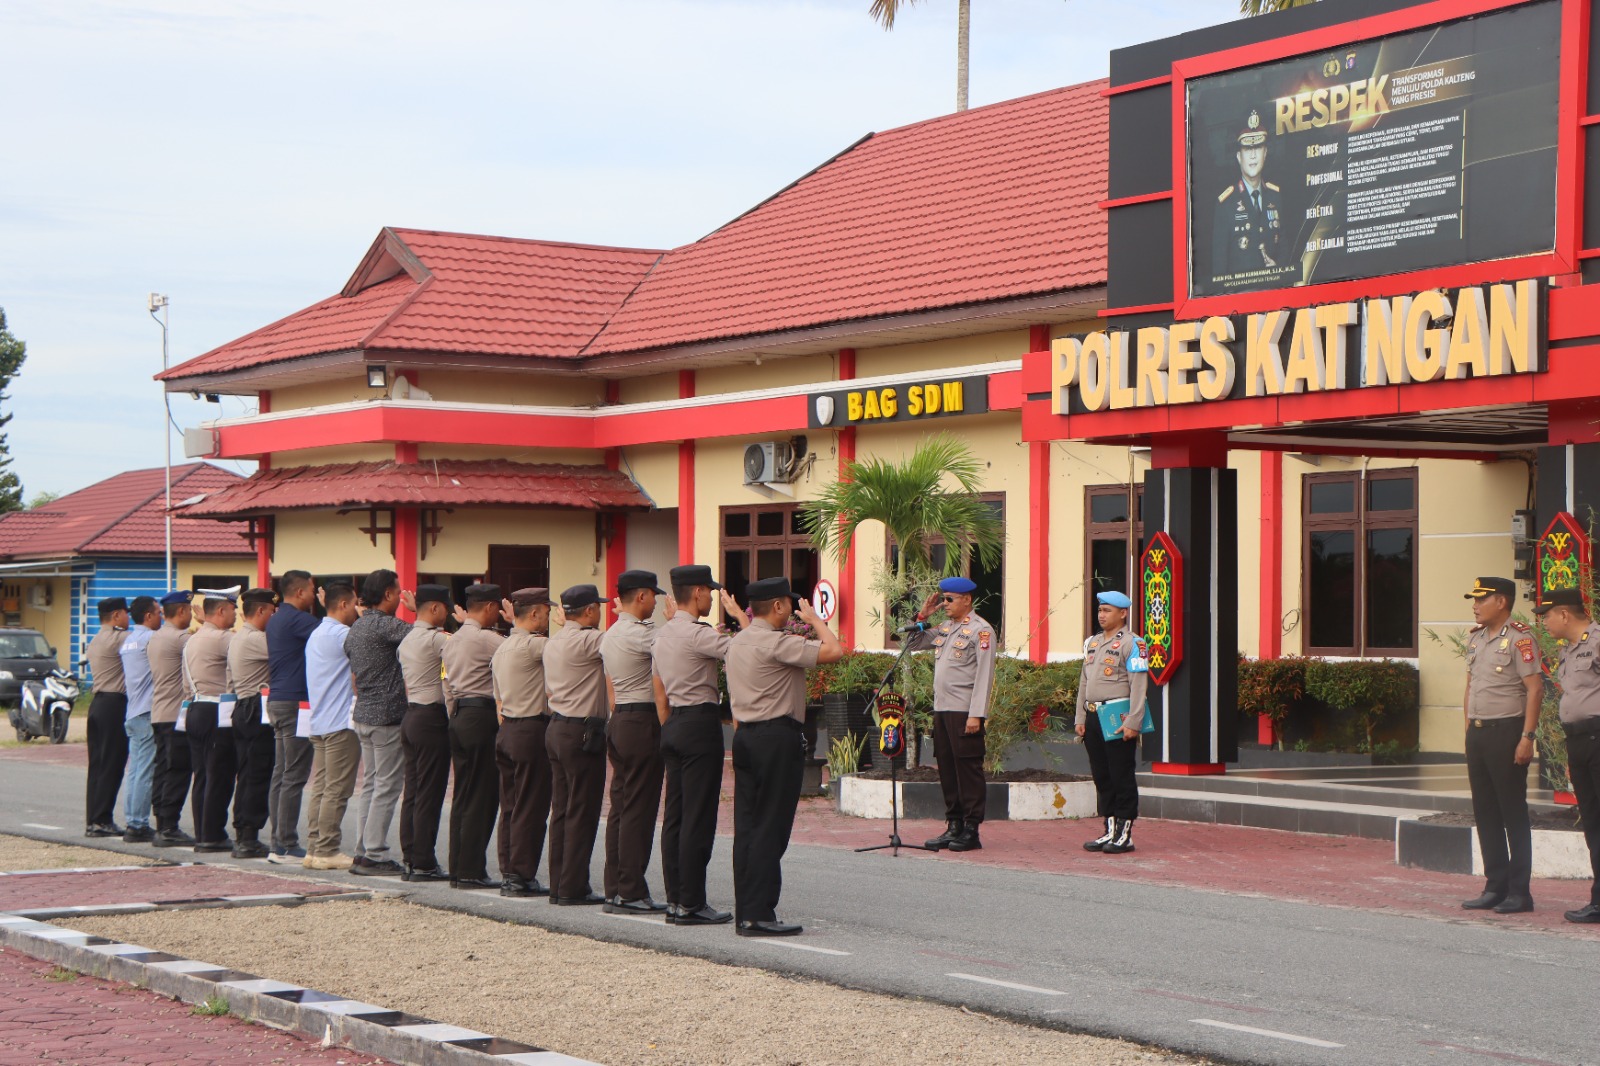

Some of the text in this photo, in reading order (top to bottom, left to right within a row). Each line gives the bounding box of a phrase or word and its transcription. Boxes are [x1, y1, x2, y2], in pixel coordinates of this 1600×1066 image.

[1391, 68, 1445, 87] TRANSFORMASI
[1391, 71, 1476, 96] MENUJU POLDA KALTENG
[1276, 74, 1390, 135] RESPEK
[1391, 89, 1437, 106] YANG PRESISI
[1306, 170, 1343, 187] PROFESIONAL
[1051, 315, 1235, 416] POLRES
[847, 381, 964, 421] BAG SDM
